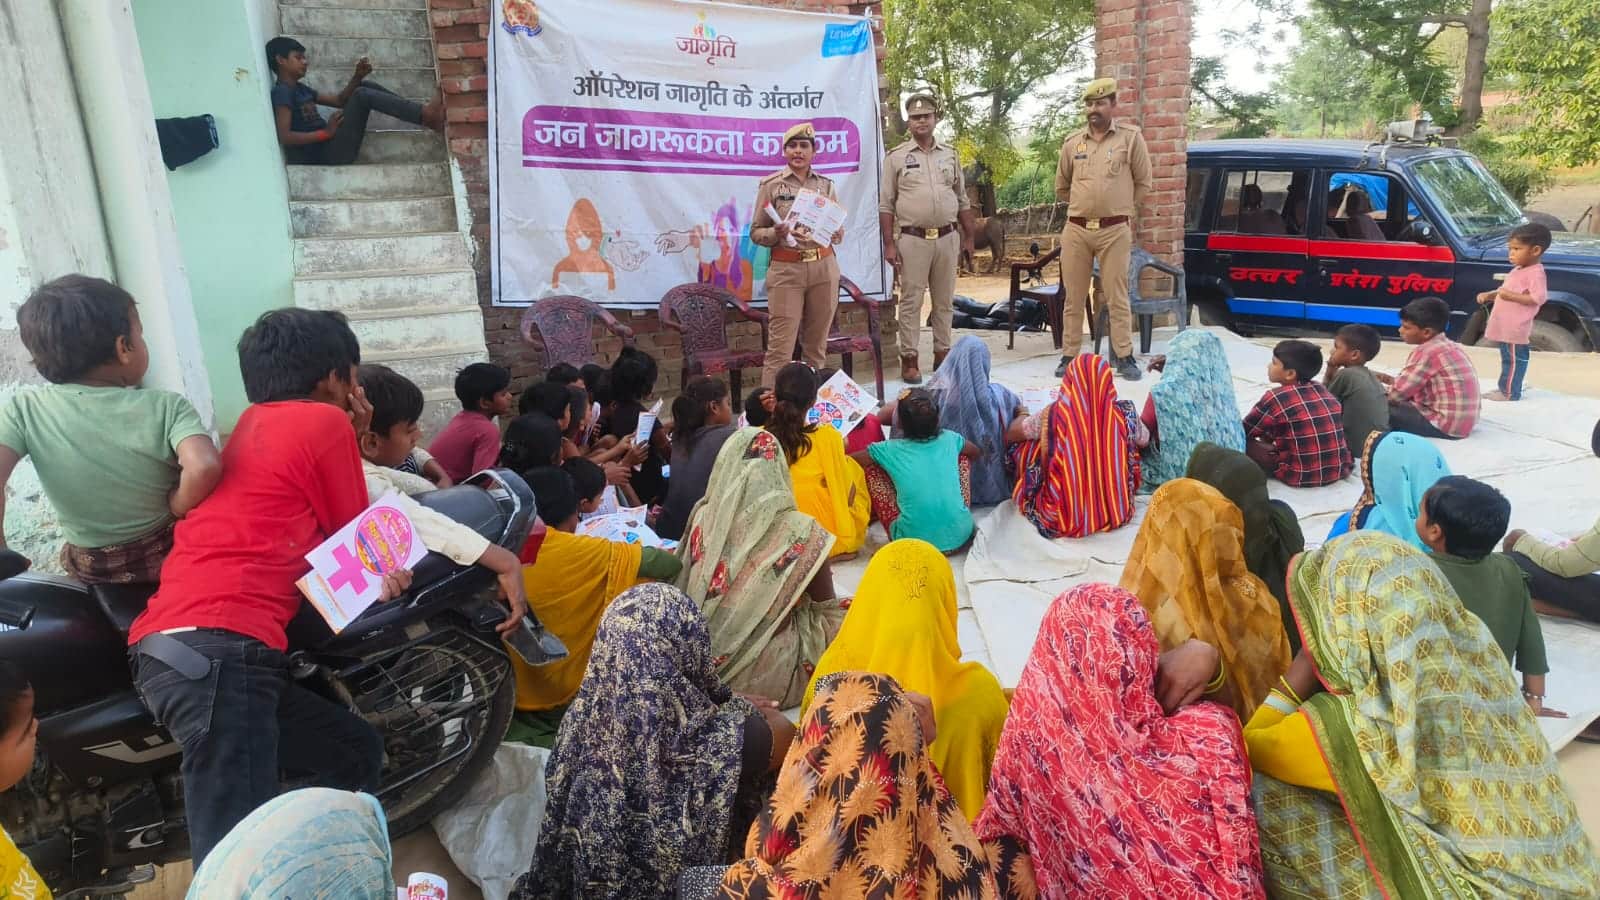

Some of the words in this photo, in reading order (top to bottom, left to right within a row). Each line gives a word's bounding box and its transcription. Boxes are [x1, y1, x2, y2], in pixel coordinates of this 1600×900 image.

[676, 36, 737, 65] जागृति
[573, 71, 660, 101] ऑपरेशन
[665, 80, 728, 111] जागृति
[733, 84, 753, 108] के
[759, 86, 824, 109] अंतर्गत
[533, 120, 588, 149] जन
[595, 123, 745, 156] जागरूकता
[1229, 267, 1303, 284] उत्तर
[1330, 269, 1382, 289] प्रदेश
[1386, 273, 1454, 294] पुलिस
